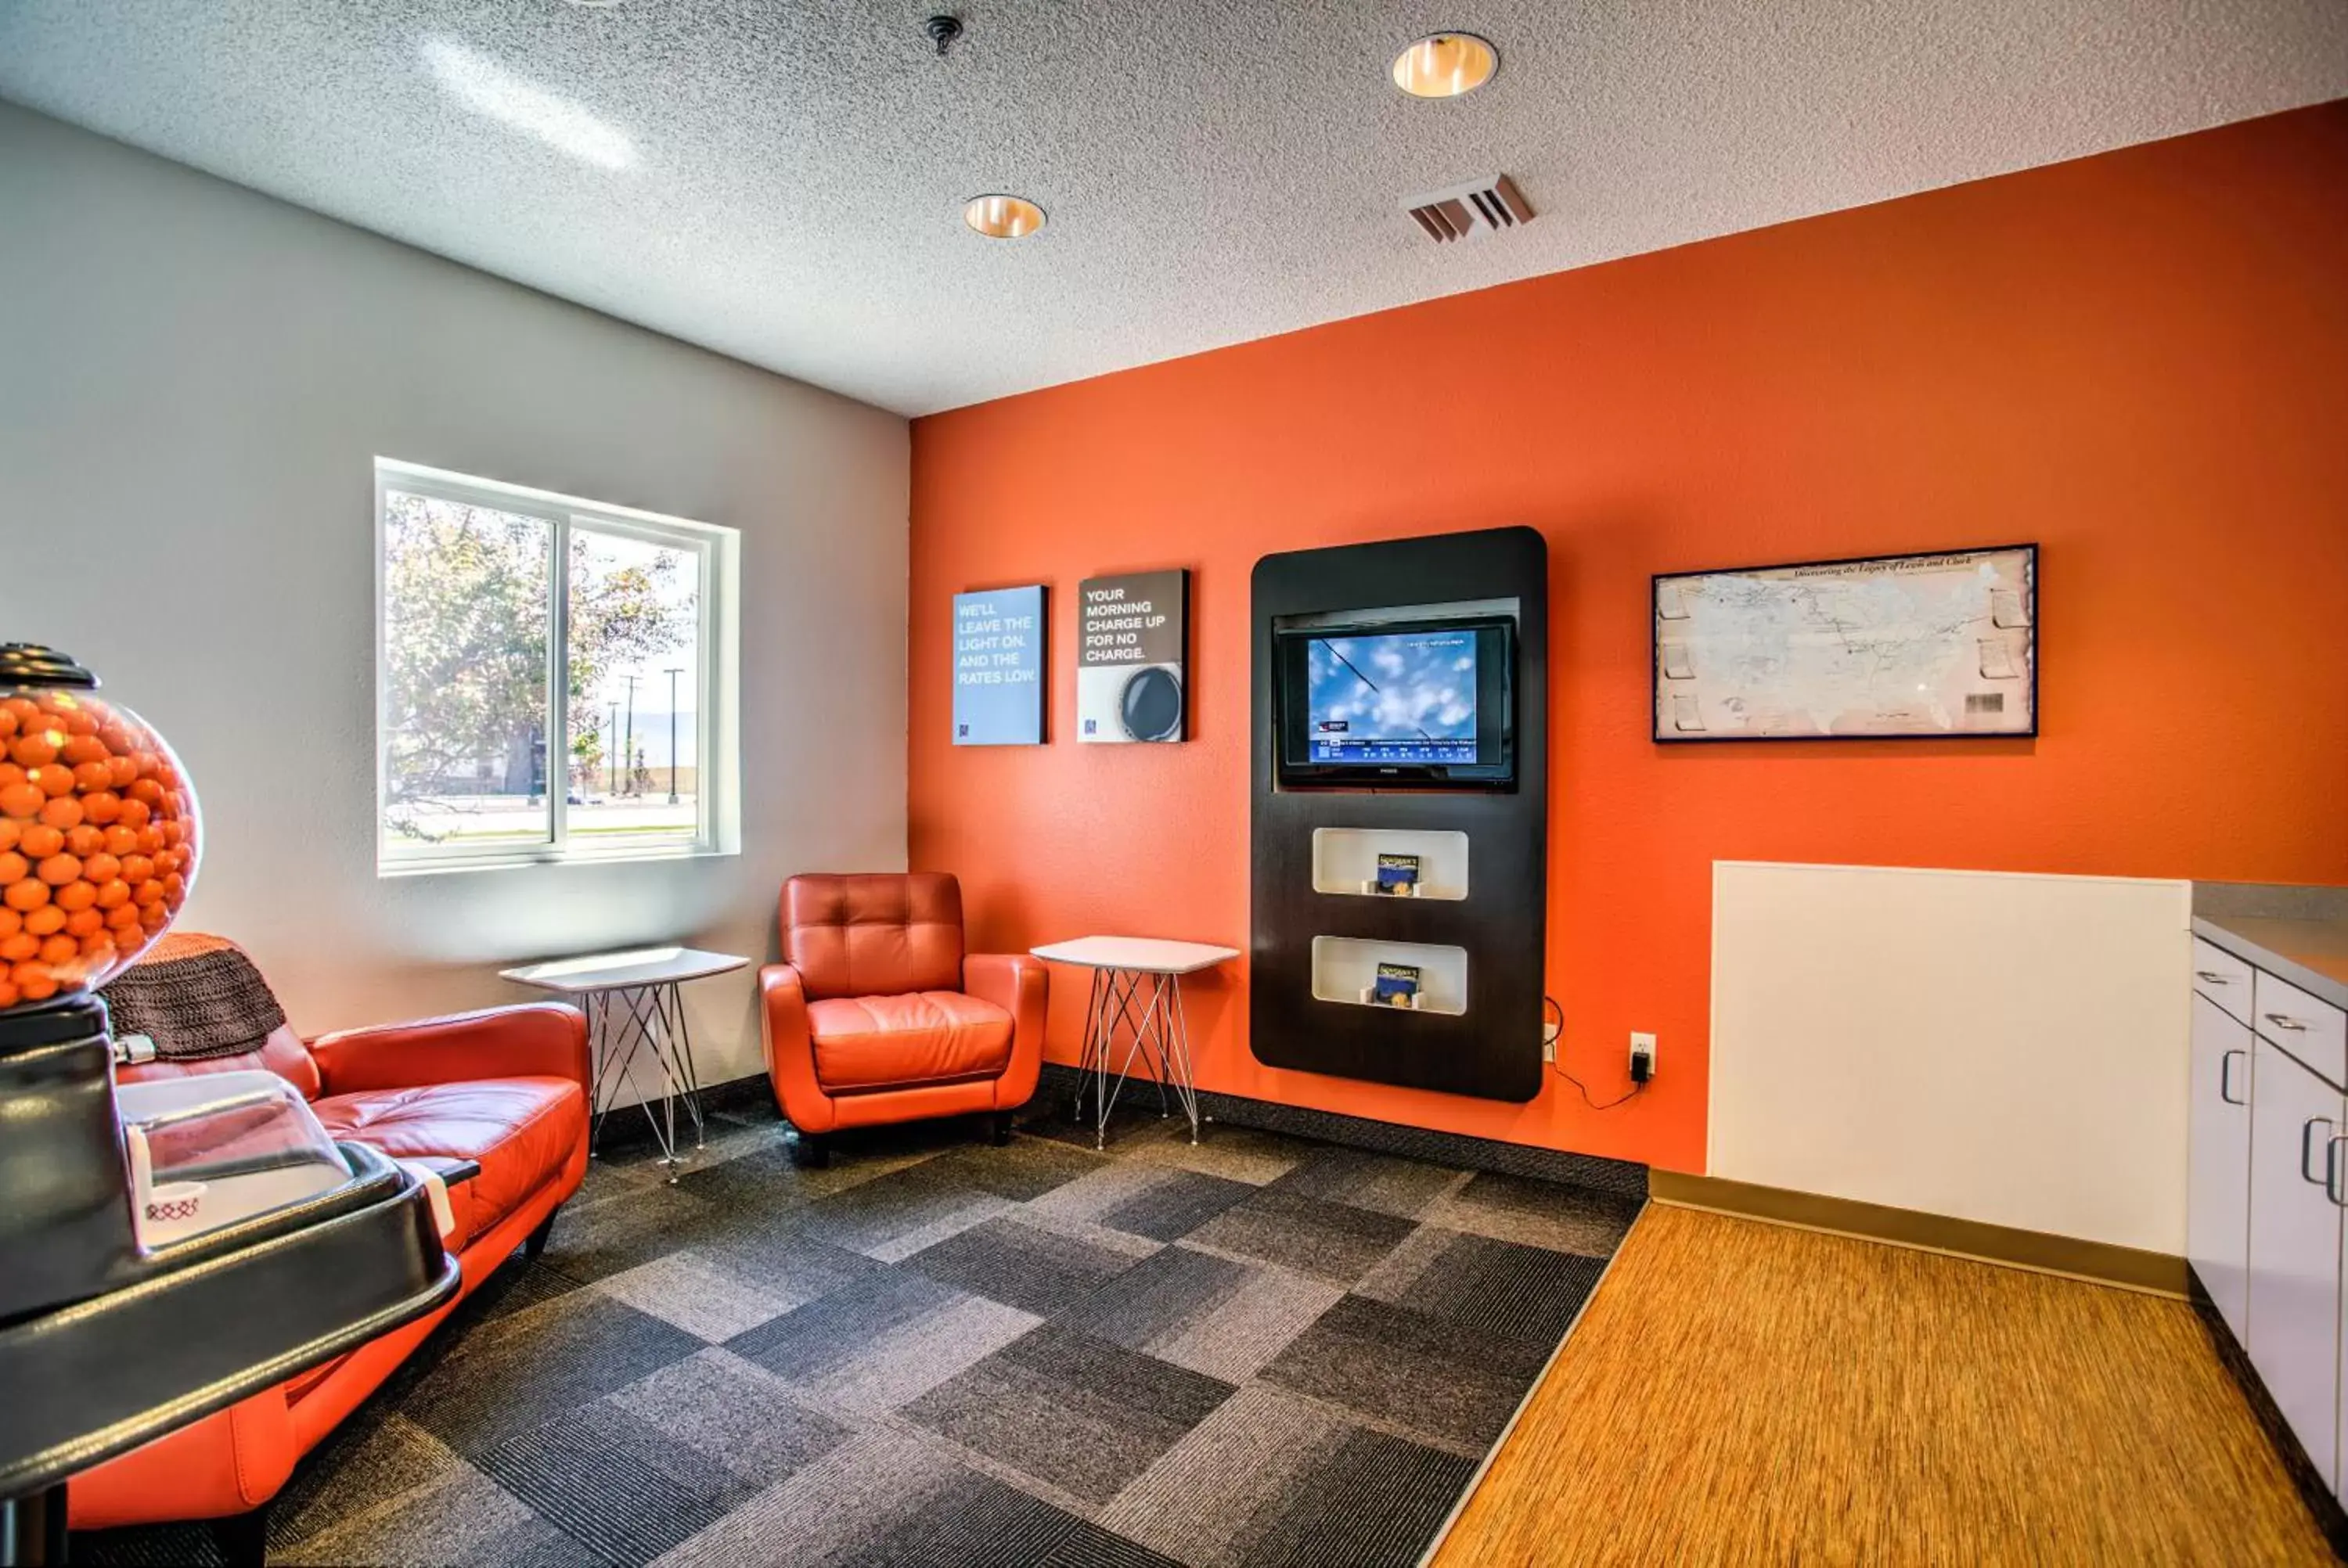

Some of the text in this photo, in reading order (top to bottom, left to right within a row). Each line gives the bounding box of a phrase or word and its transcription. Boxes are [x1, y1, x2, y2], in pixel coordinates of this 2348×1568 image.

[1087, 589, 1125, 602] YOUR
[960, 604, 996, 617] WE'LL
[1087, 602, 1151, 617] MORNING
[960, 616, 1033, 635] LEAVE THE
[1087, 616, 1165, 631] CHARGE UP
[960, 637, 998, 651] LIGHT
[1087, 633, 1137, 646] FOR NO
[960, 653, 1019, 667] AND THE
[1087, 648, 1145, 661] CHARGE.
[960, 671, 1001, 685] RATES
